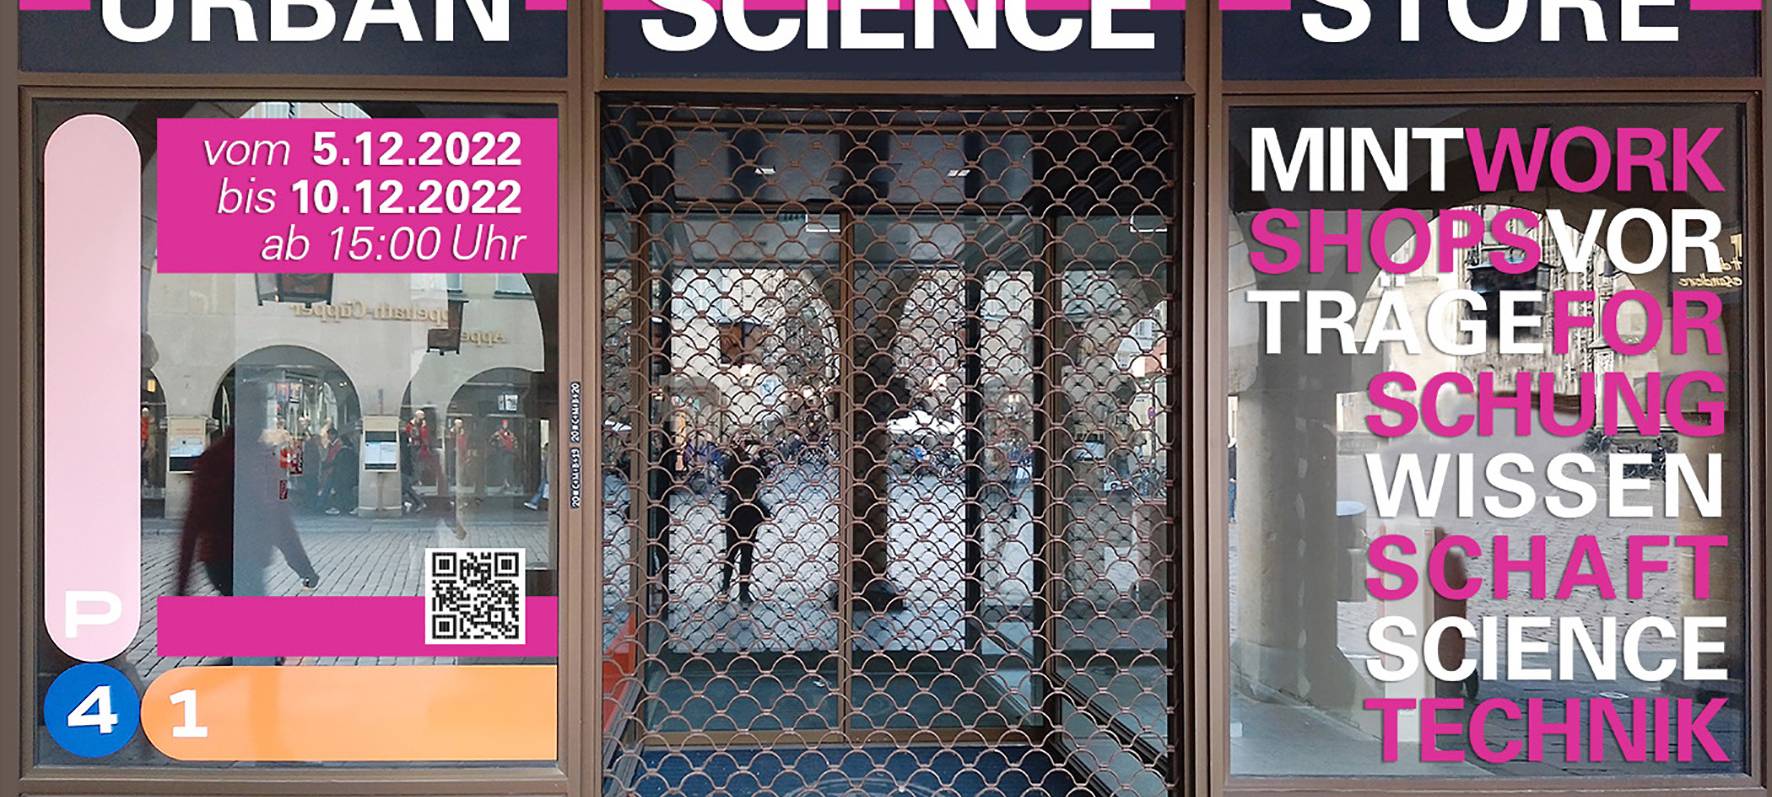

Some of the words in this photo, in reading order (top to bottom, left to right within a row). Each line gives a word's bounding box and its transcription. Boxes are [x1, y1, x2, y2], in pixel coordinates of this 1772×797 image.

[102, 0, 510, 43] URBAN
[641, 0, 1155, 51] SCIENCE
[203, 139, 289, 165] vom
[312, 131, 521, 166] 5.12.2022
[217, 177, 276, 214] bis
[291, 179, 521, 214] 10.12.2022
[261, 225, 309, 261] ab
[329, 226, 441, 261] 15:00
[452, 224, 527, 261] Uhr
[1366, 371, 1725, 437] SCHUNG
[1365, 453, 1722, 518] WISSEN
[1365, 534, 1728, 600] SCHAFT
[64, 590, 122, 638] P
[1366, 616, 1728, 681] SCIENCE
[67, 685, 118, 733] 4
[169, 689, 208, 738] 1
[1364, 698, 1729, 763] TECHNIK
